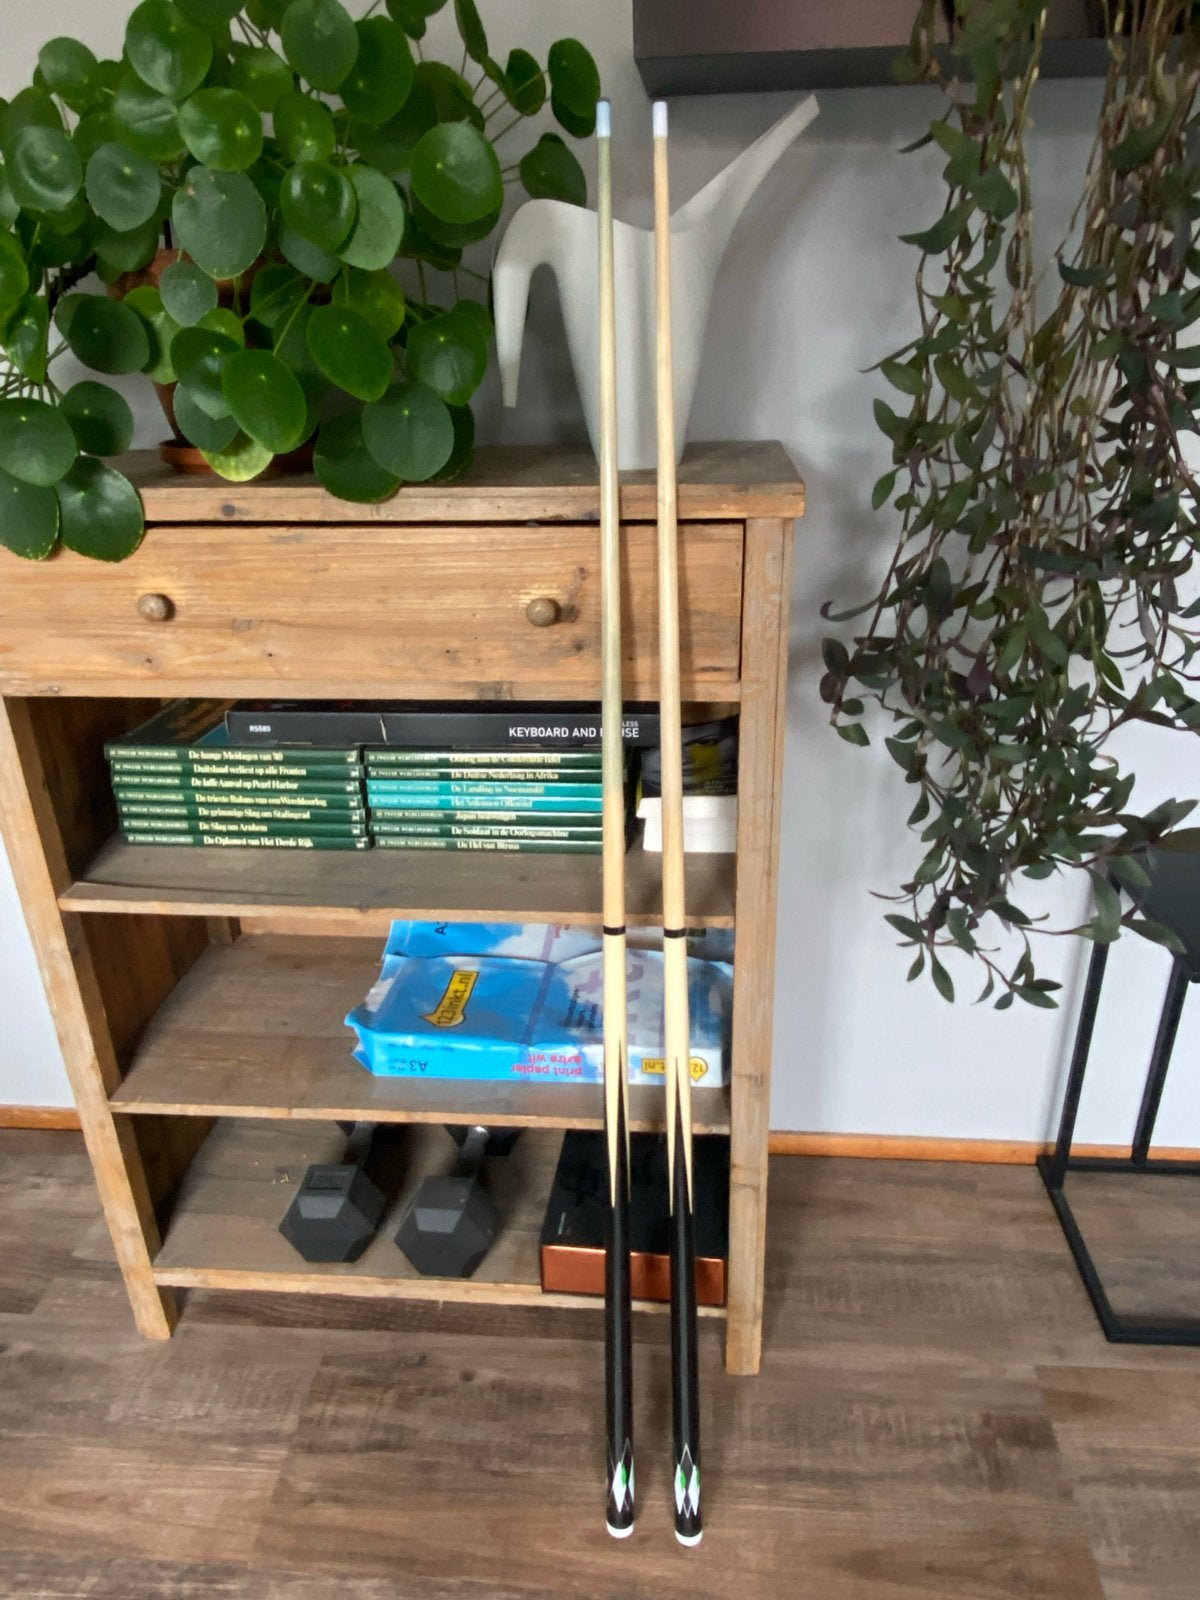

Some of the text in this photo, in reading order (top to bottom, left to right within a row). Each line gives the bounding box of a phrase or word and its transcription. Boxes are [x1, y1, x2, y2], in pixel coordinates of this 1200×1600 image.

[509, 727, 569, 737] KEYBOARD
[572, 728, 597, 737] AND
[259, 753, 272, 761] van
[265, 766, 278, 775] alle
[279, 766, 307, 776] Fronten
[252, 780, 271, 789] Pearl
[198, 807, 209, 816] De
[244, 808, 261, 818] Slag
[273, 810, 311, 819] Stalingrad
[199, 822, 210, 830] De
[210, 822, 227, 831] Slag
[239, 823, 268, 832] Arnhem
[260, 837, 275, 846] Het
[298, 838, 313, 847] Rijk
[435, 922, 449, 935] A
[437, 973, 474, 1025] 123inkt.nl
[550, 1054, 582, 1063] extra
[410, 1060, 429, 1072] A3
[512, 1064, 582, 1075] print papier
[643, 1061, 704, 1073] 12t.nl
